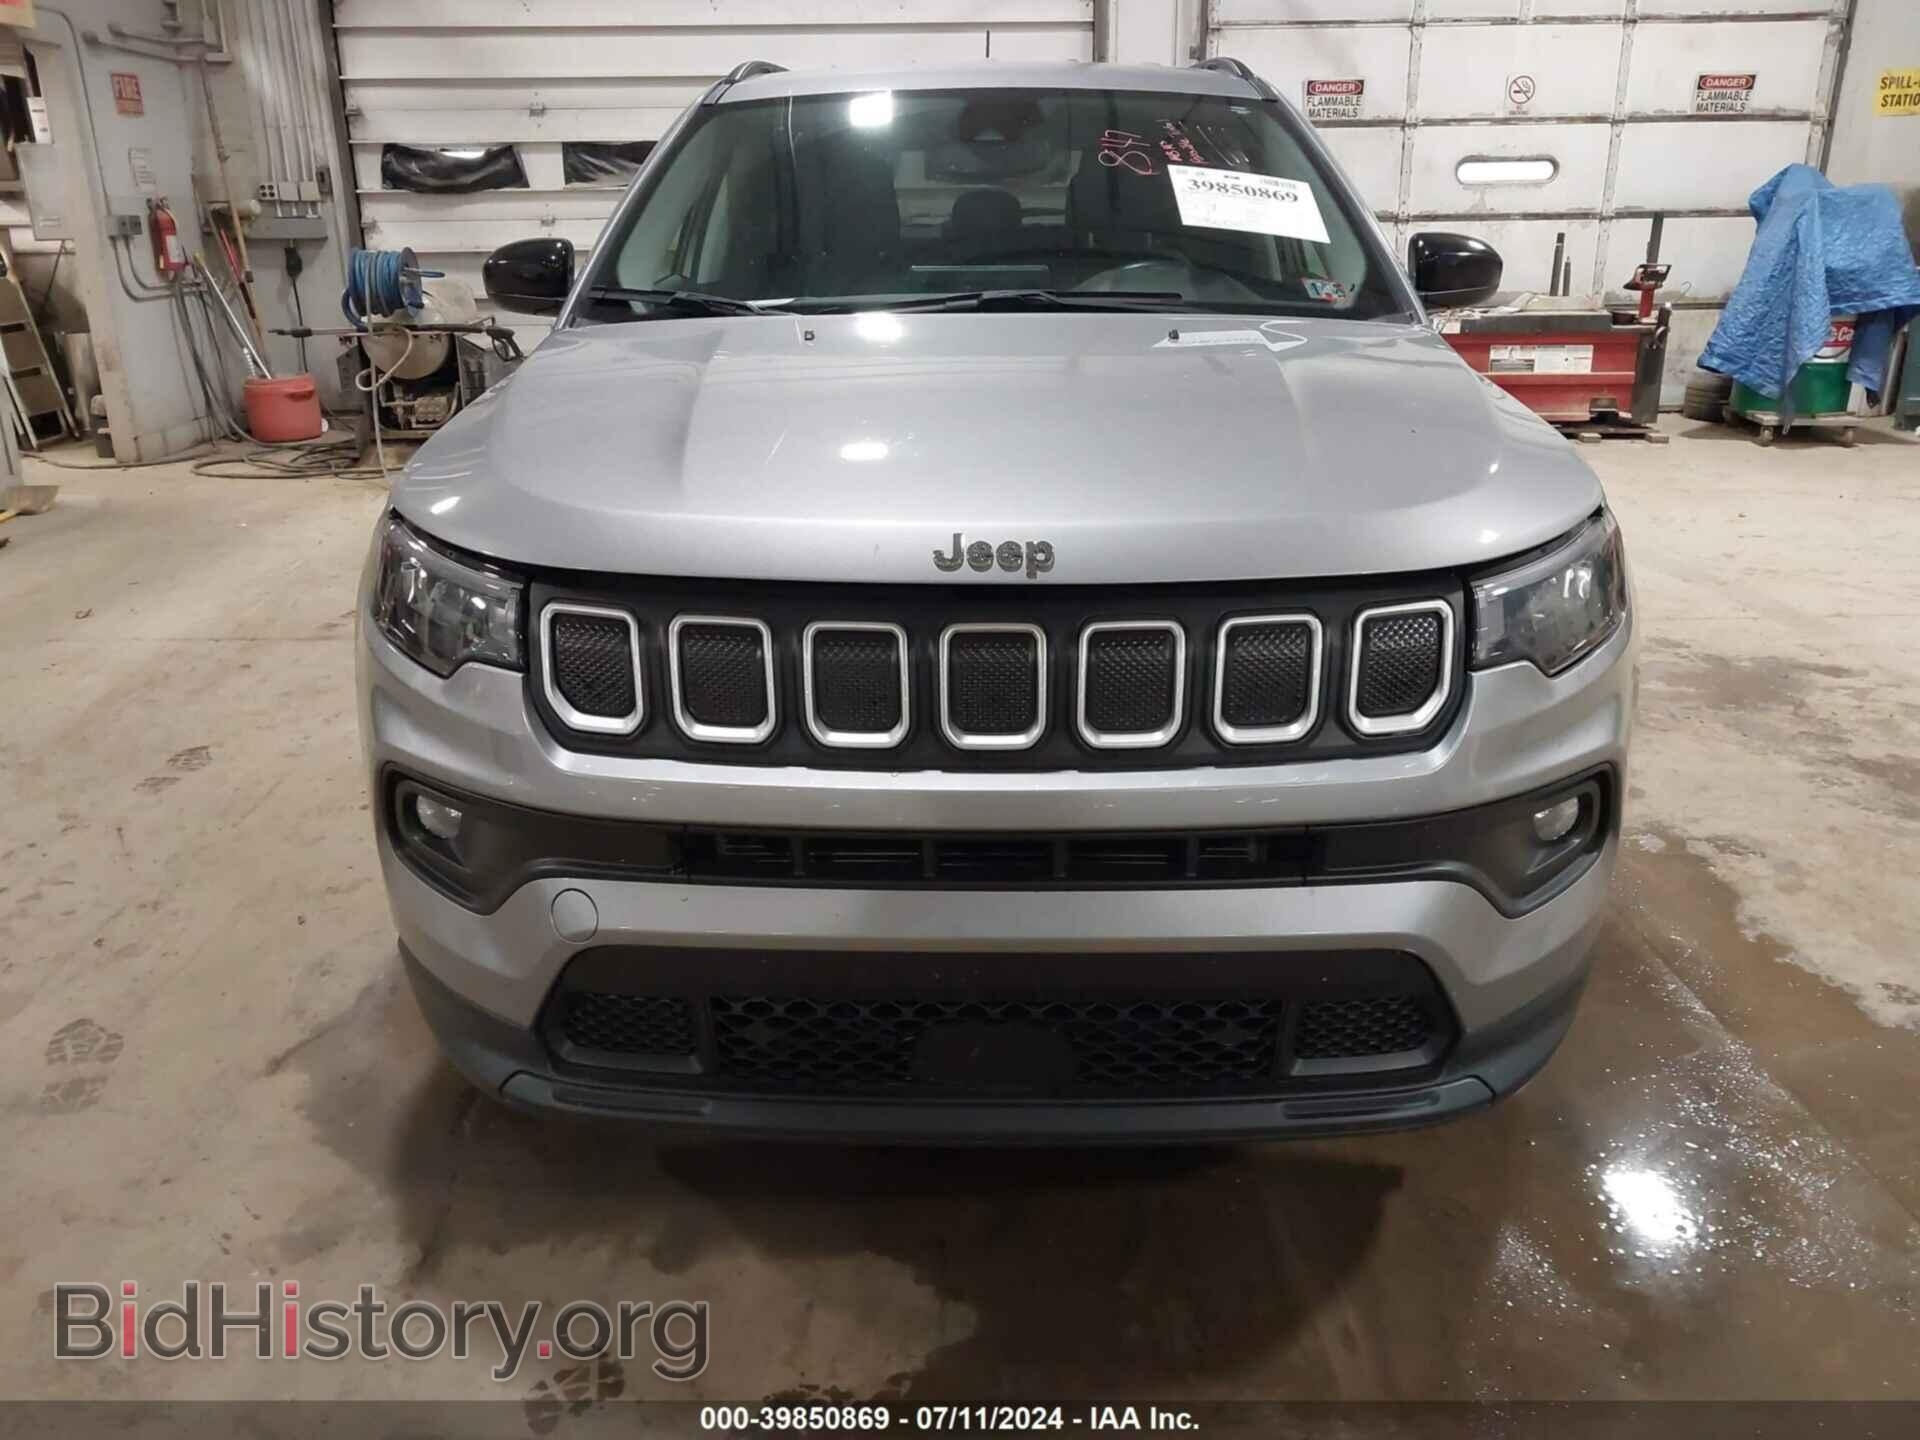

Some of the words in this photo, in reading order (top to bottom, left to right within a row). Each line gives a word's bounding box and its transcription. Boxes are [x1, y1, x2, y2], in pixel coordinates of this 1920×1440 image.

[1315, 83, 1356, 92] DANGER
[1706, 78, 1747, 88] DANGER
[1880, 75, 1920, 90] SPILL-
[1306, 95, 1361, 107] FLAMMABLE
[1696, 90, 1752, 101] FLAMMABLE
[1308, 107, 1359, 118] MATERIALS
[1696, 102, 1746, 112] MATERIALS
[1187, 177, 1299, 203] 39850869
[932, 533, 1055, 580] Jeep
